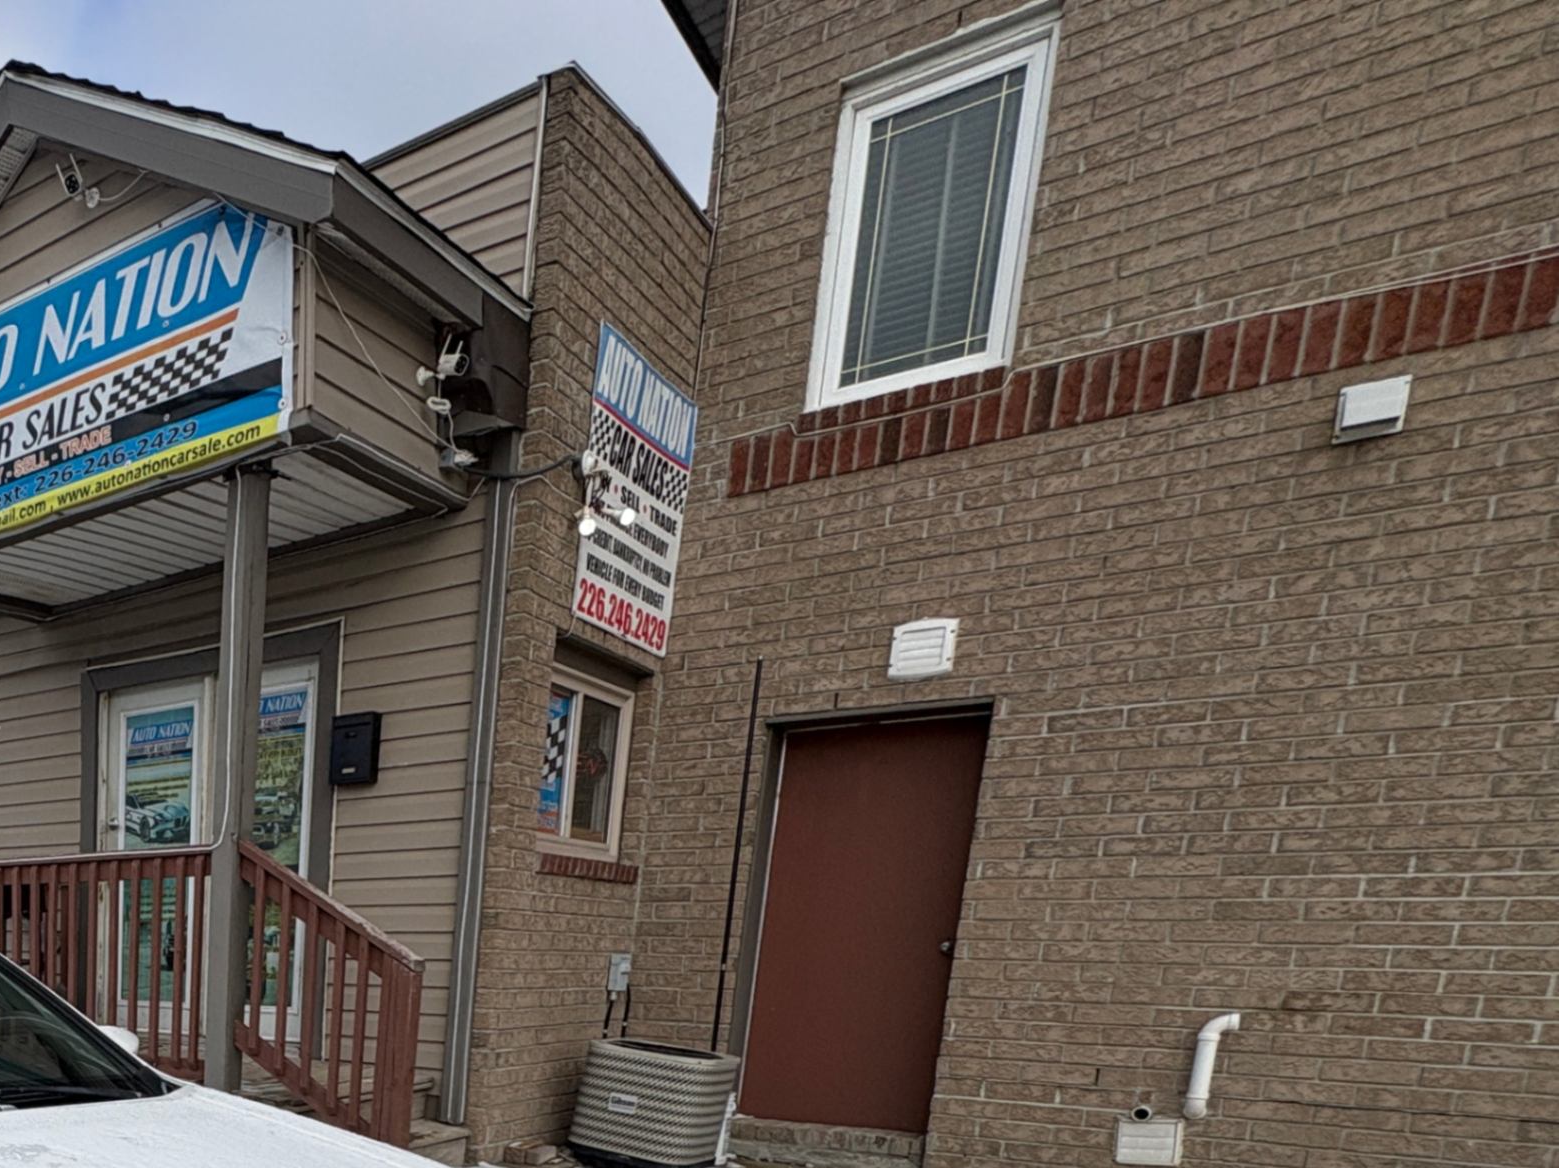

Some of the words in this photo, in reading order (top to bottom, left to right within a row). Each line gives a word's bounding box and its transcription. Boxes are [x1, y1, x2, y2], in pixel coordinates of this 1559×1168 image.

[34, 210, 256, 375] NATION
[22, 382, 106, 450] SALES
[597, 334, 643, 419] AUTO
[637, 368, 693, 459] NATION
[13, 454, 49, 478] SELL
[59, 425, 113, 461] TRADE
[34, 420, 198, 493] 226-246-2429
[56, 423, 261, 506] www.autonationcarsale.com
[609, 423, 636, 479] CAR
[631, 442, 669, 501] SALES
[620, 485, 640, 514] SELL
[650, 504, 678, 537] TRADE
[577, 577, 667, 652] 226.246.2429
[132, 726, 157, 742] AUTO
[158, 720, 192, 740] NATION
[264, 692, 305, 714] NATION
